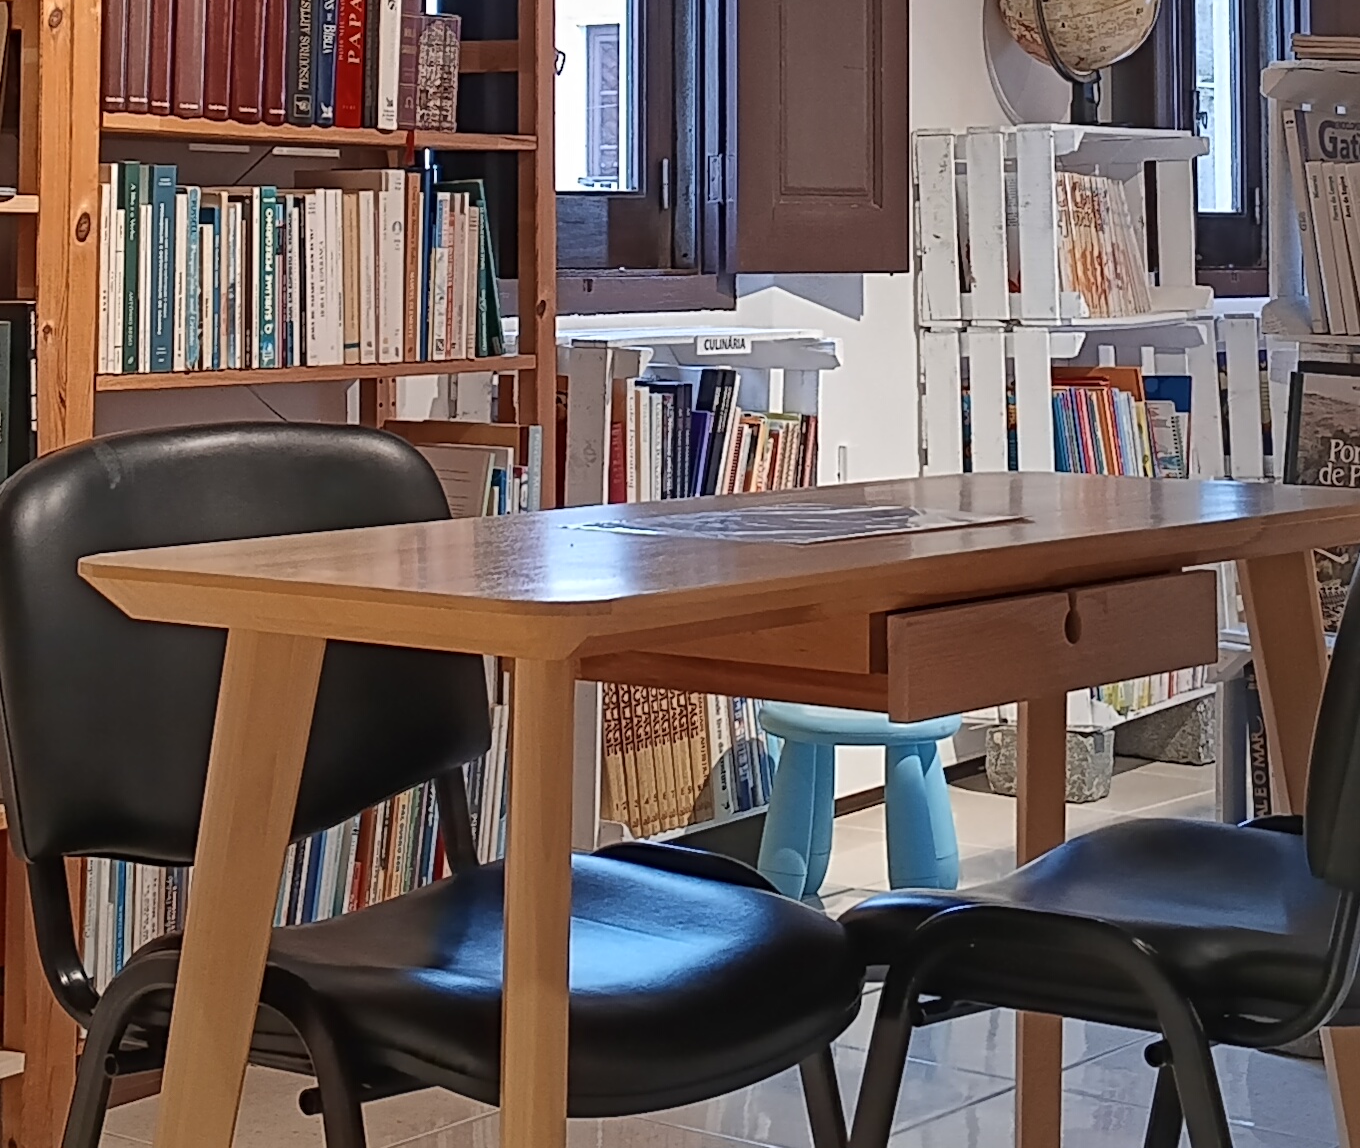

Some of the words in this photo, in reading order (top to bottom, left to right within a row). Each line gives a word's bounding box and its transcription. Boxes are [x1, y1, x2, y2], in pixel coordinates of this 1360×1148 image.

[298, 36, 312, 90] TESOUROS
[265, 207, 273, 272] PEREGRINO
[264, 274, 273, 319] SUBLIME
[704, 336, 746, 351] CULINÁRIA
[1318, 463, 1344, 486] de
